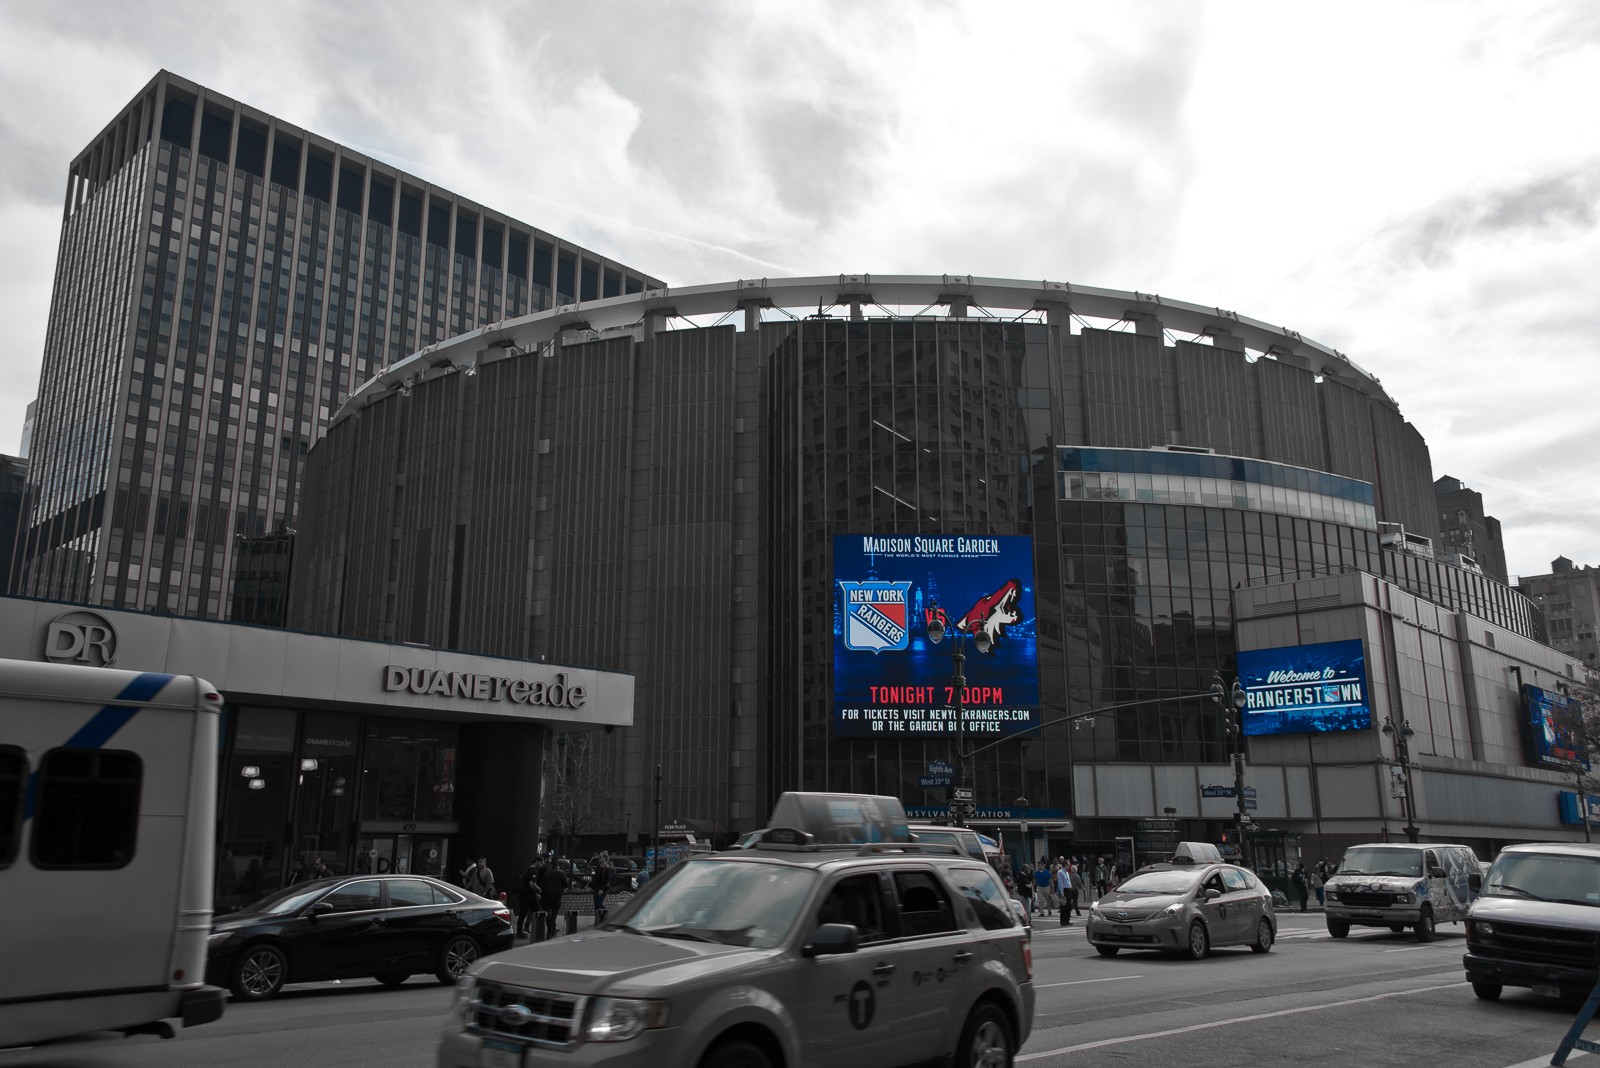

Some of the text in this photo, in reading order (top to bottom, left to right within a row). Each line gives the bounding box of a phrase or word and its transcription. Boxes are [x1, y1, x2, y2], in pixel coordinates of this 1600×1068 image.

[863, 536, 911, 553] MADISON
[914, 536, 954, 554] SQUARE
[850, 589, 905, 602] NEW YORK
[857, 604, 904, 643] RANGERS
[45, 621, 117, 664] DR
[1267, 666, 1335, 683] Welcome to
[870, 686, 1003, 705] TONIGHT 700PM
[842, 709, 859, 720] FOR
[864, 709, 899, 720] TICKETS
[903, 709, 925, 720] VISIT
[872, 721, 884, 731] OR
[888, 721, 905, 731] THE
[909, 721, 944, 731] GARDEN
[969, 721, 1001, 732] OFFICE
[944, 777, 951, 785] St
